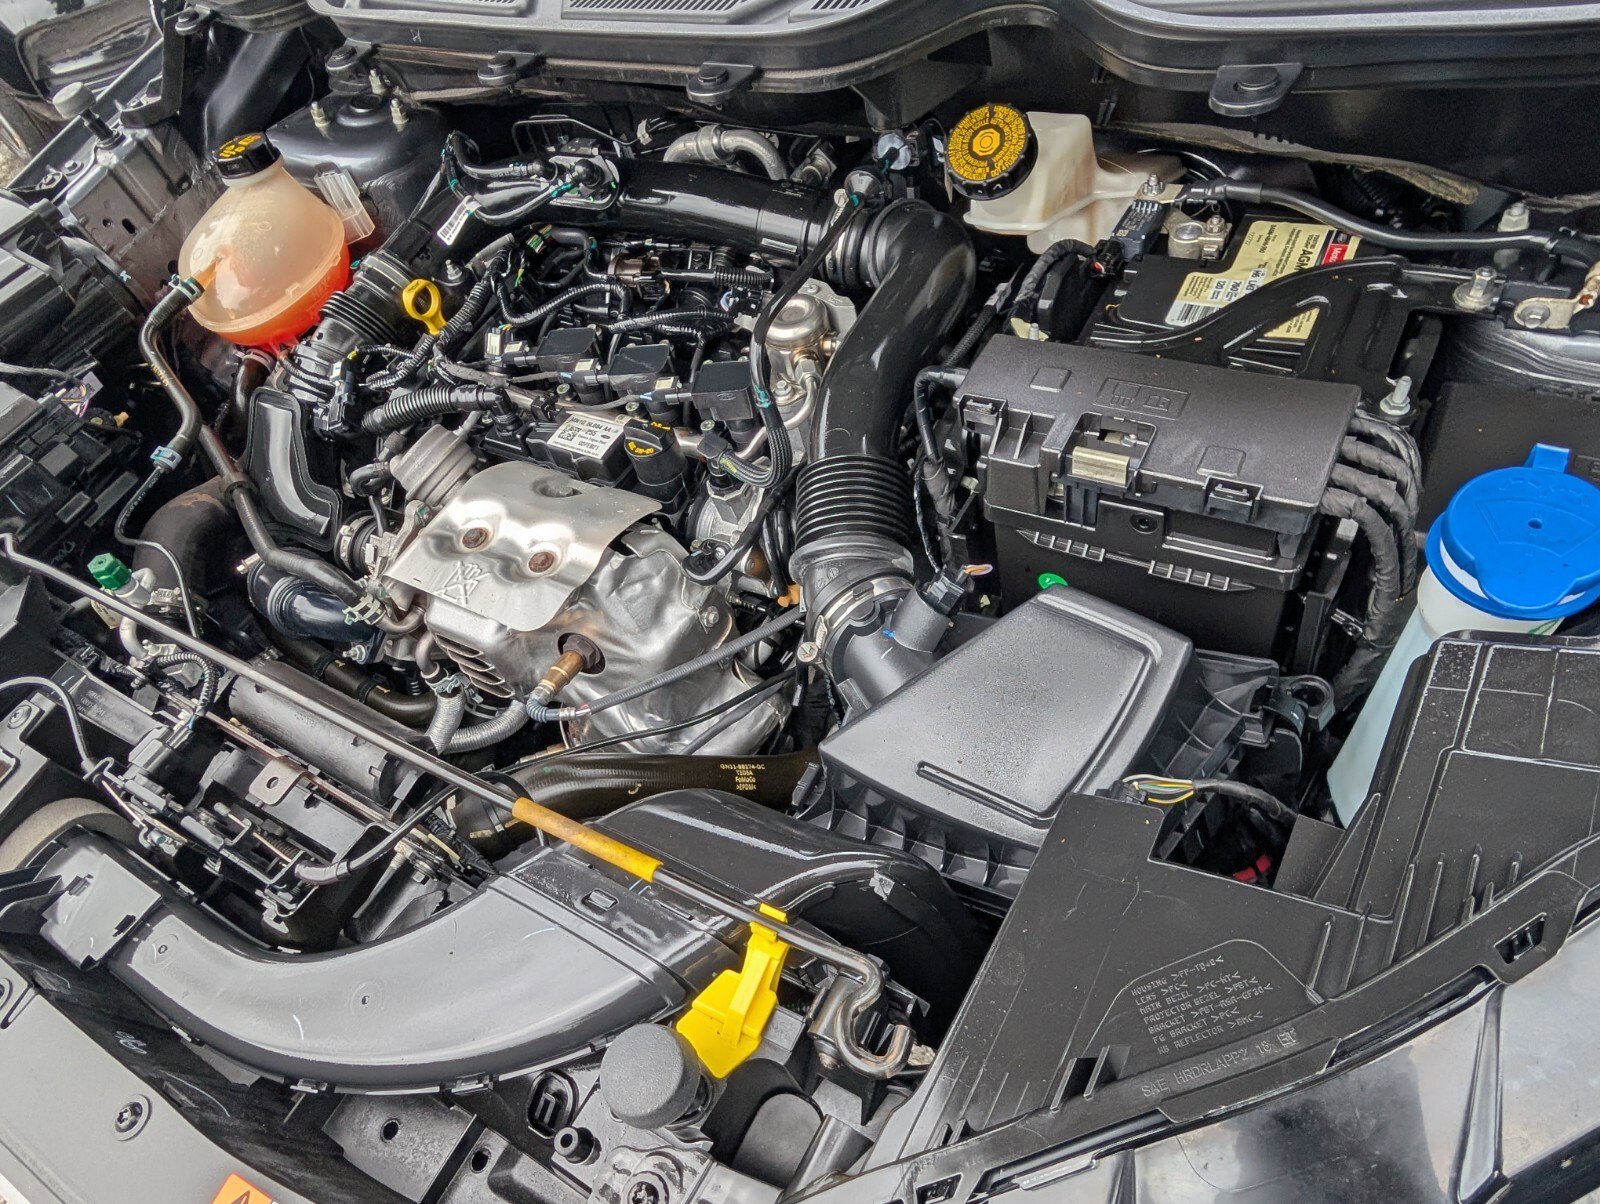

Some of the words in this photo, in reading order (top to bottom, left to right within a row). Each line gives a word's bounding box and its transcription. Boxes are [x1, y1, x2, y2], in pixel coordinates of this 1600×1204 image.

[1215, 281, 1226, 289] 120
[1230, 281, 1242, 291] 760
[1131, 977, 1167, 996] HOUSING
[1135, 993, 1157, 1006] LENS
[1139, 1001, 1162, 1015] MAIN
[1167, 990, 1193, 1005] BEZEL
[1143, 1001, 1193, 1024] PROTECTOR
[1194, 991, 1221, 1006] BEZEL
[1148, 1014, 1186, 1035] BRACKET
[1169, 1018, 1208, 1038] BRACKET
[1174, 1025, 1224, 1049] REFLECTOR
[1141, 1078, 1169, 1097] SAE
